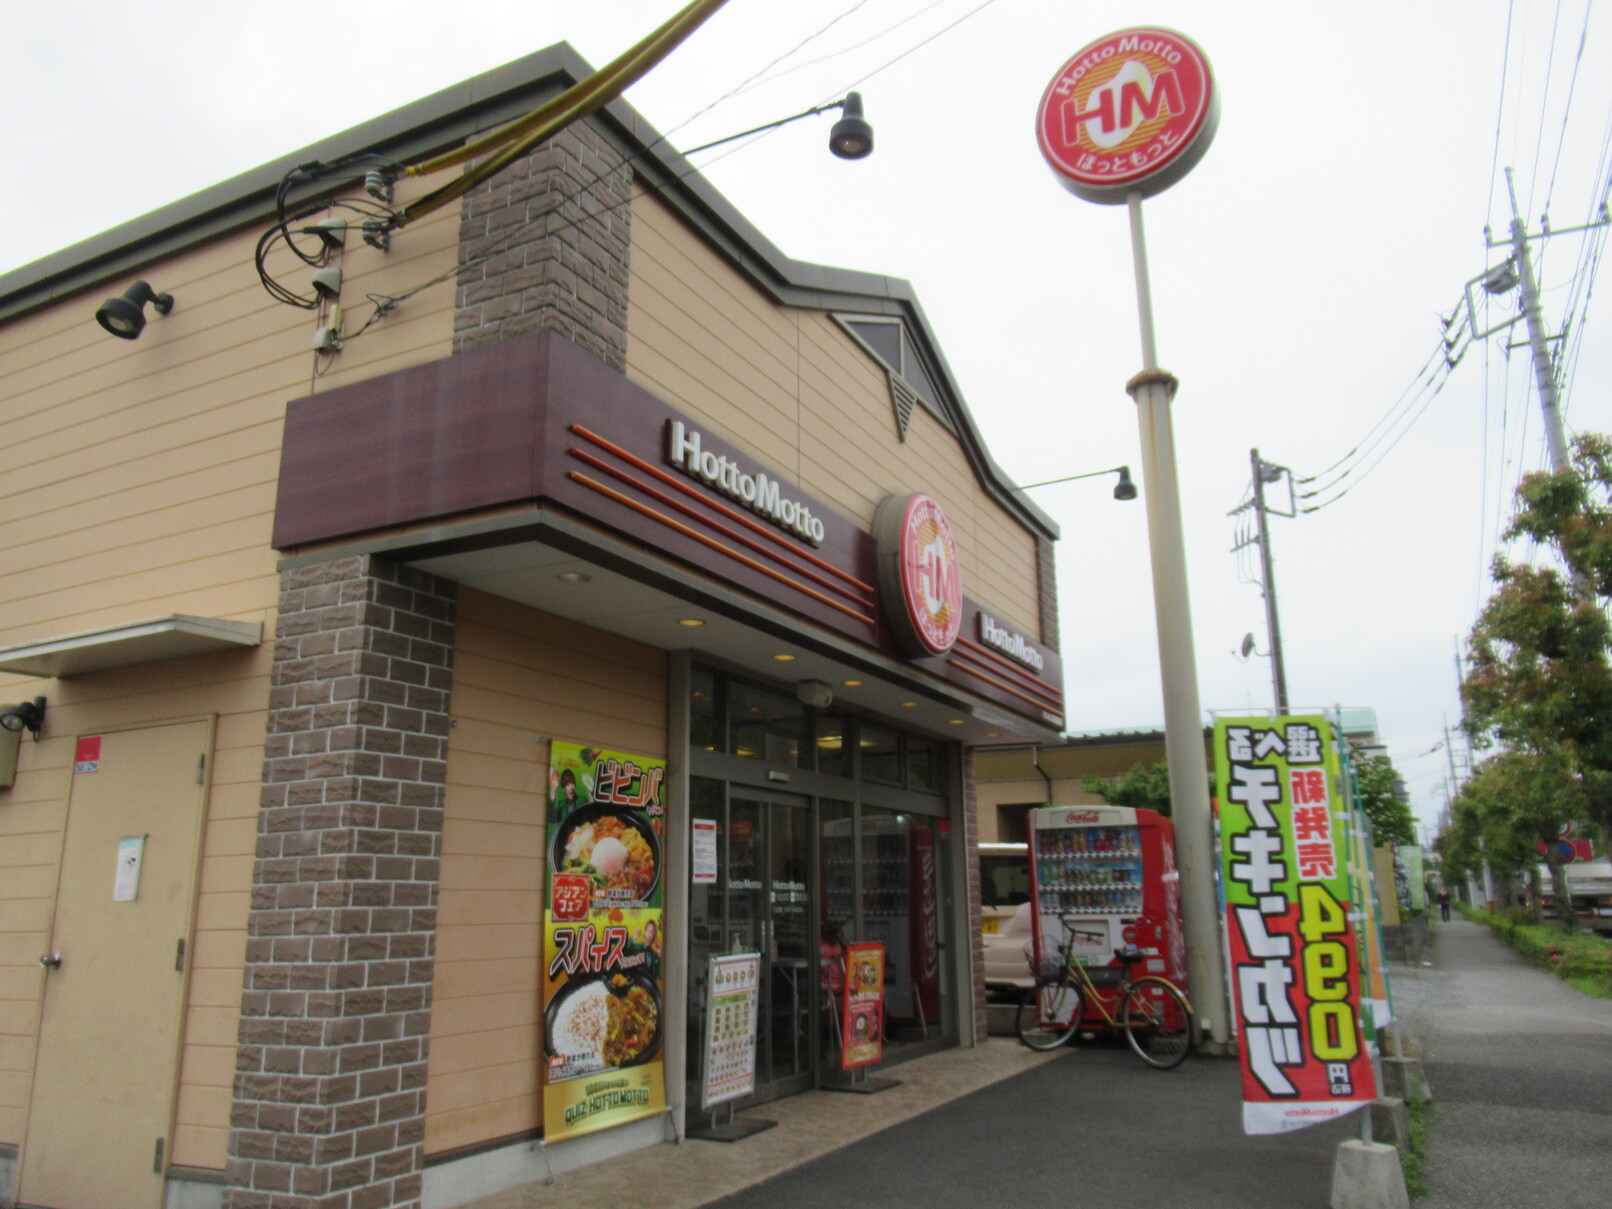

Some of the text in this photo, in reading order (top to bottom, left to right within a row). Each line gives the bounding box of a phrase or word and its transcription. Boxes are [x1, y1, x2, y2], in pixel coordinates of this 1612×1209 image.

[1077, 130, 1179, 173] ほっともっと
[593, 759, 664, 807] ビビンバ
[555, 885, 588, 899] アジアン
[559, 899, 583, 913] フェア
[549, 924, 628, 976] スパイス
